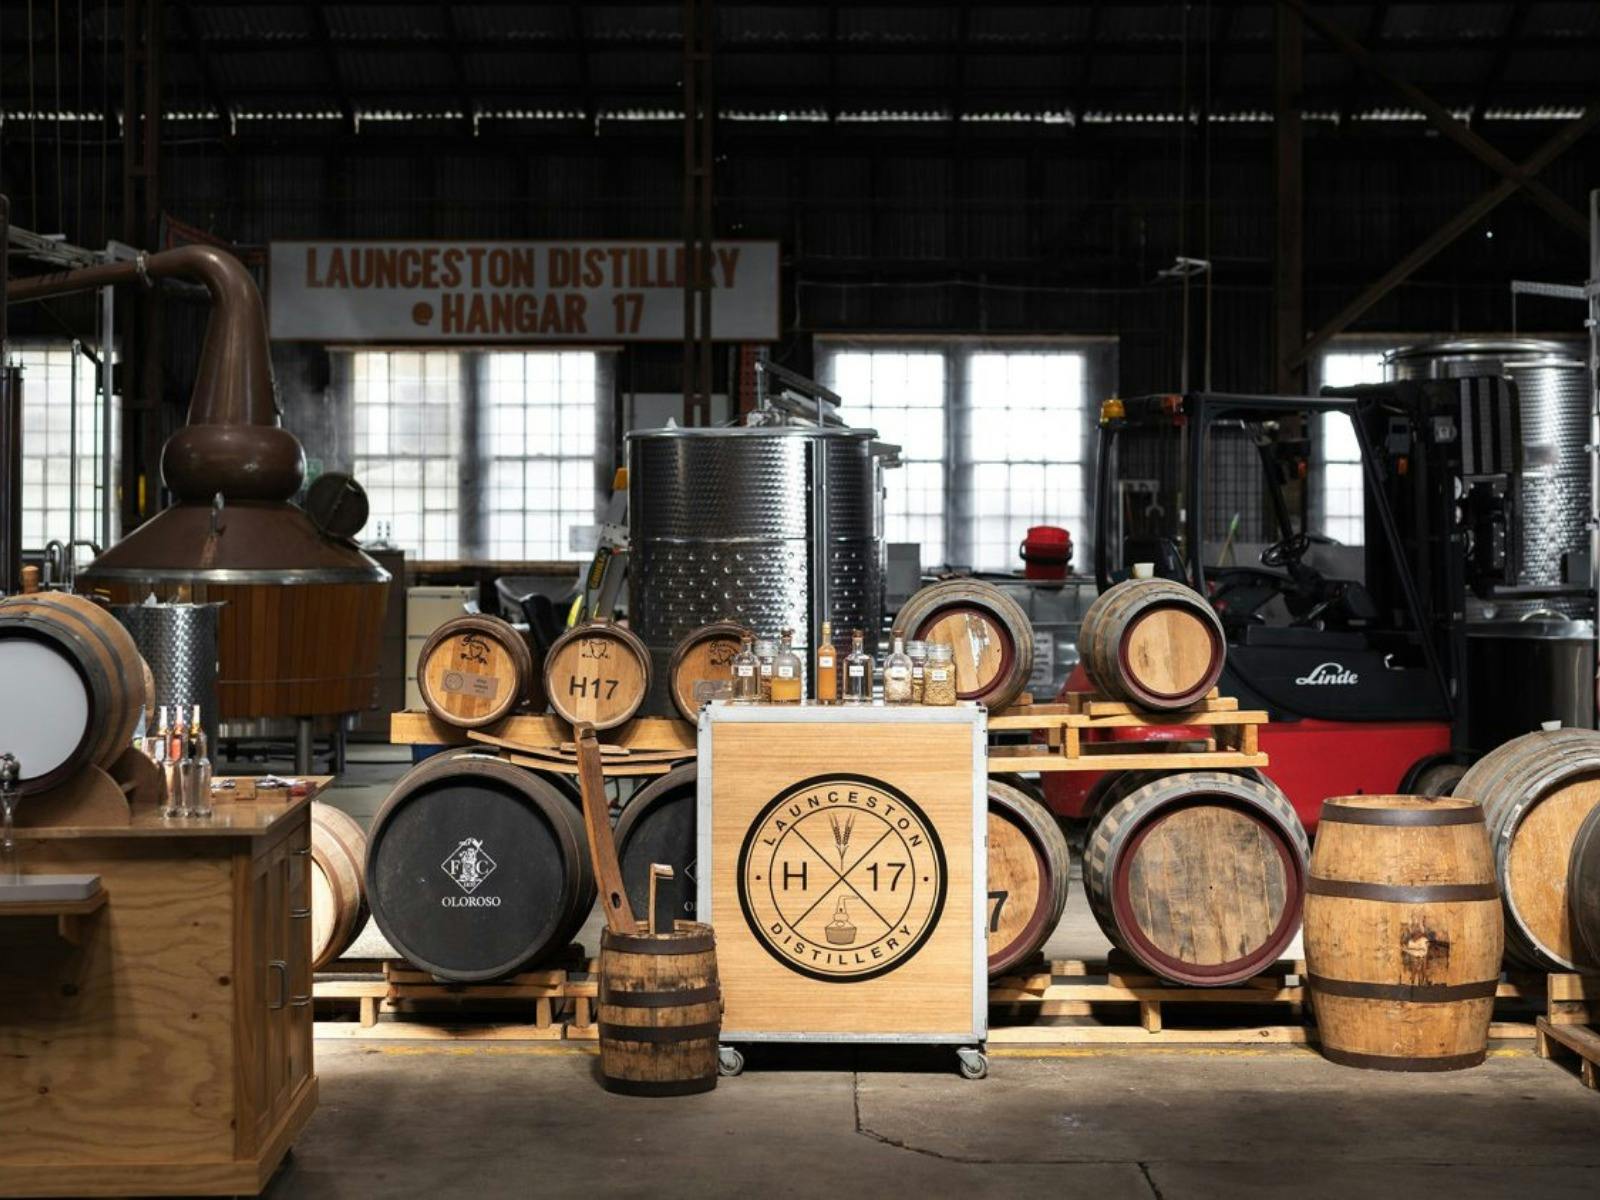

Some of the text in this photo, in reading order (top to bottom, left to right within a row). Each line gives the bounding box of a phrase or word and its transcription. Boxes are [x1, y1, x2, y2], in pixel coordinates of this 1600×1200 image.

[306, 248, 535, 289] LAUNCESTON
[612, 294, 645, 333] 17
[569, 676, 619, 700] H17
[1295, 662, 1358, 685] Linde
[763, 791, 923, 848] LAUNCESTON
[783, 862, 906, 891] H 17
[441, 896, 502, 907] OLOROSO
[771, 922, 912, 965] DISTILLERY
